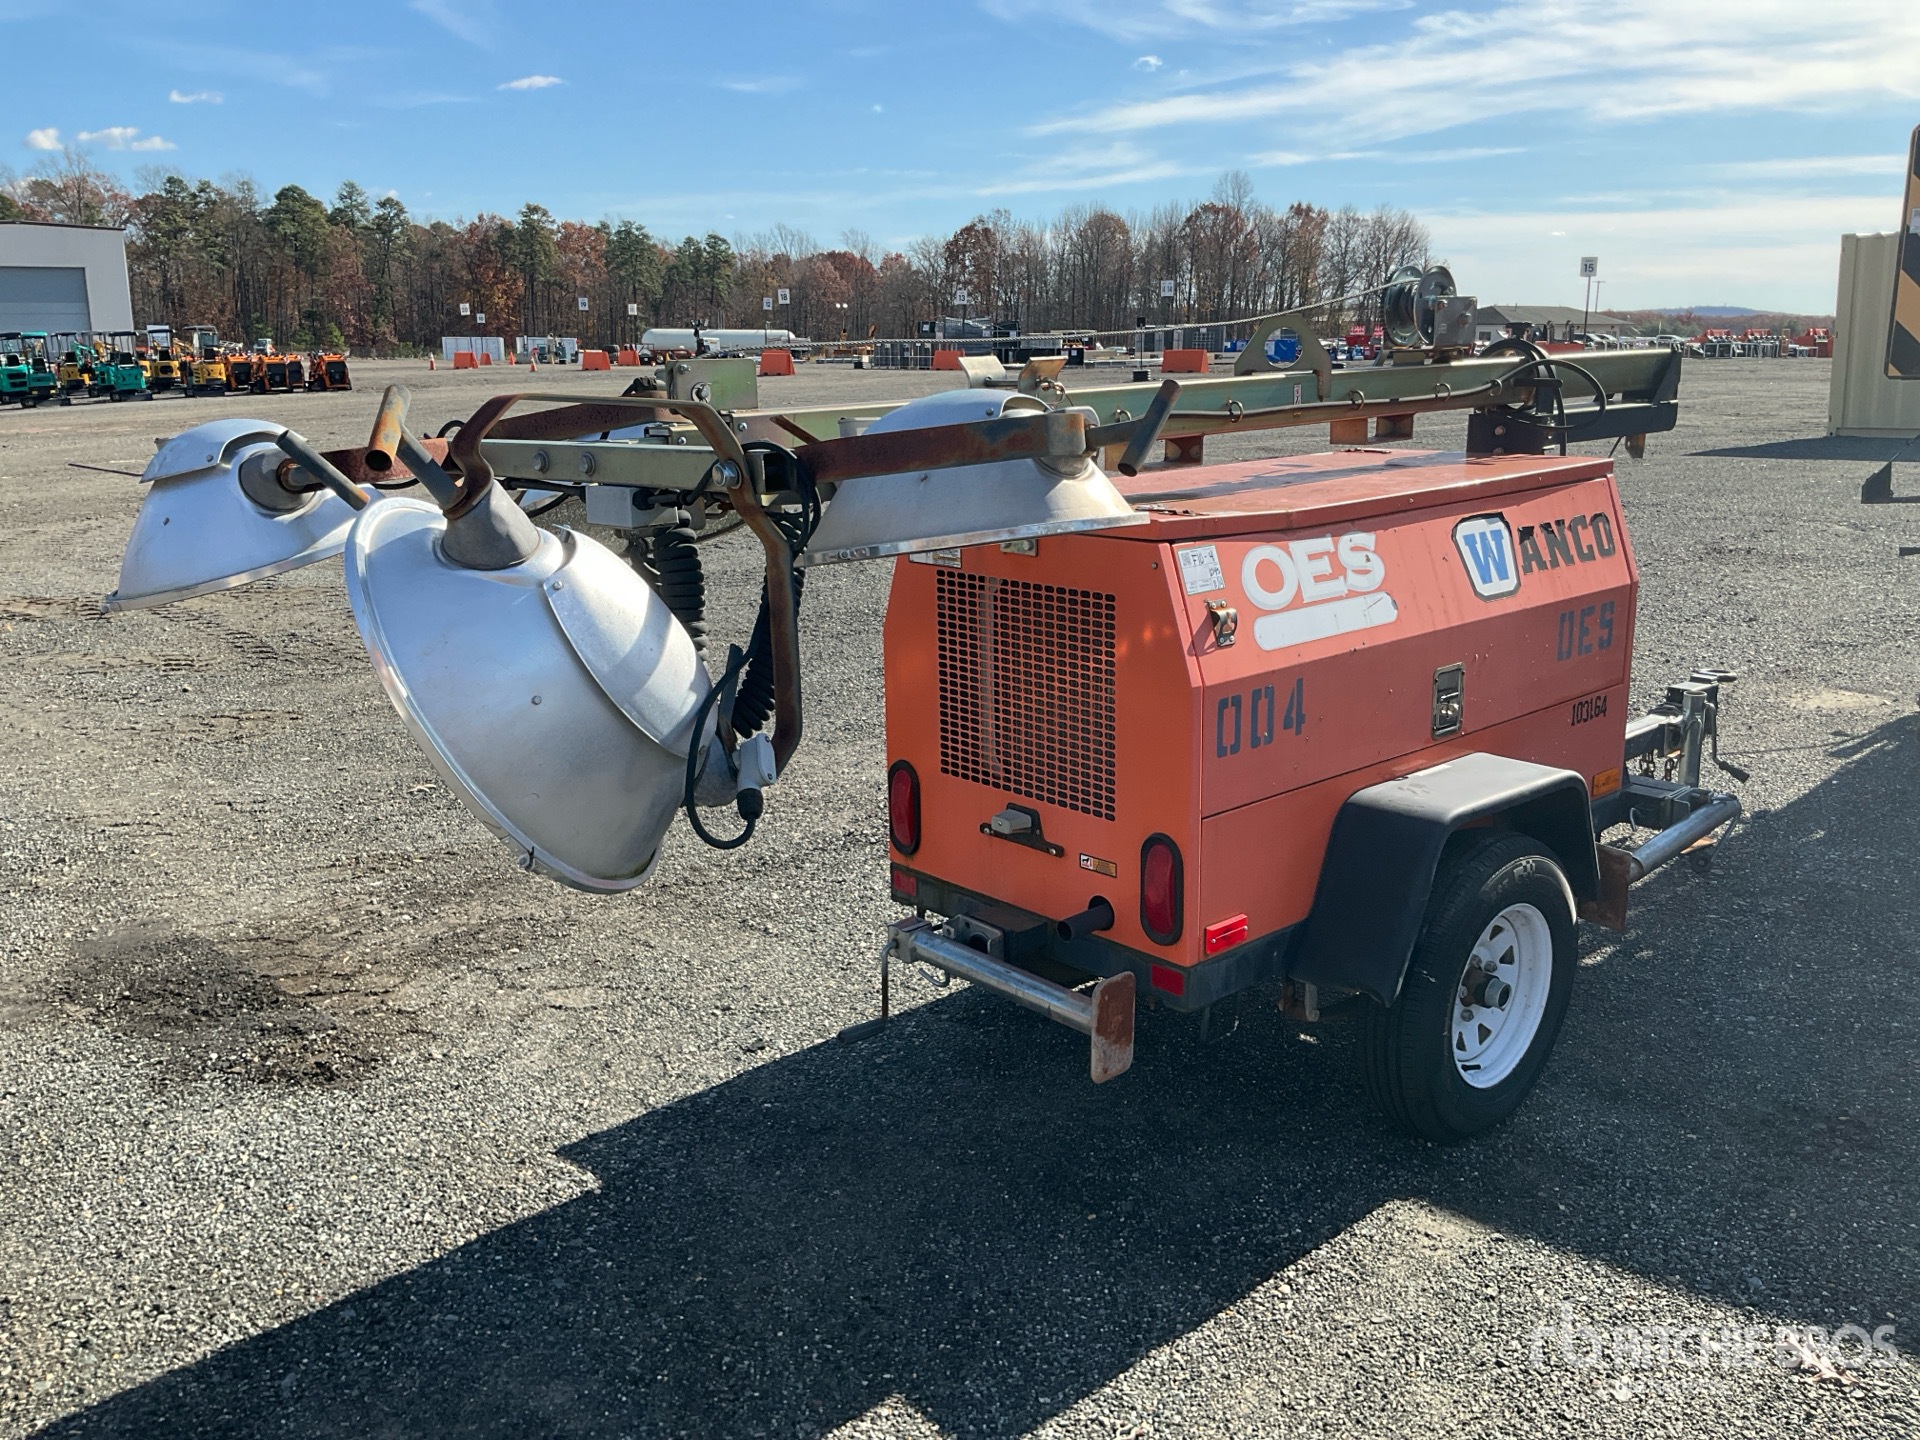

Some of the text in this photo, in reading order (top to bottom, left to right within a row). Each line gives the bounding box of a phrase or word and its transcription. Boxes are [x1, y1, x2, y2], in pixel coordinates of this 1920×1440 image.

[1584, 263, 1595, 273] 15
[780, 293, 788, 301] 18
[958, 294, 966, 302] 13
[1241, 531, 1386, 611] OES
[1556, 600, 1615, 662] OES
[1216, 676, 1306, 759] 004
[1570, 695, 1608, 727] 103164
